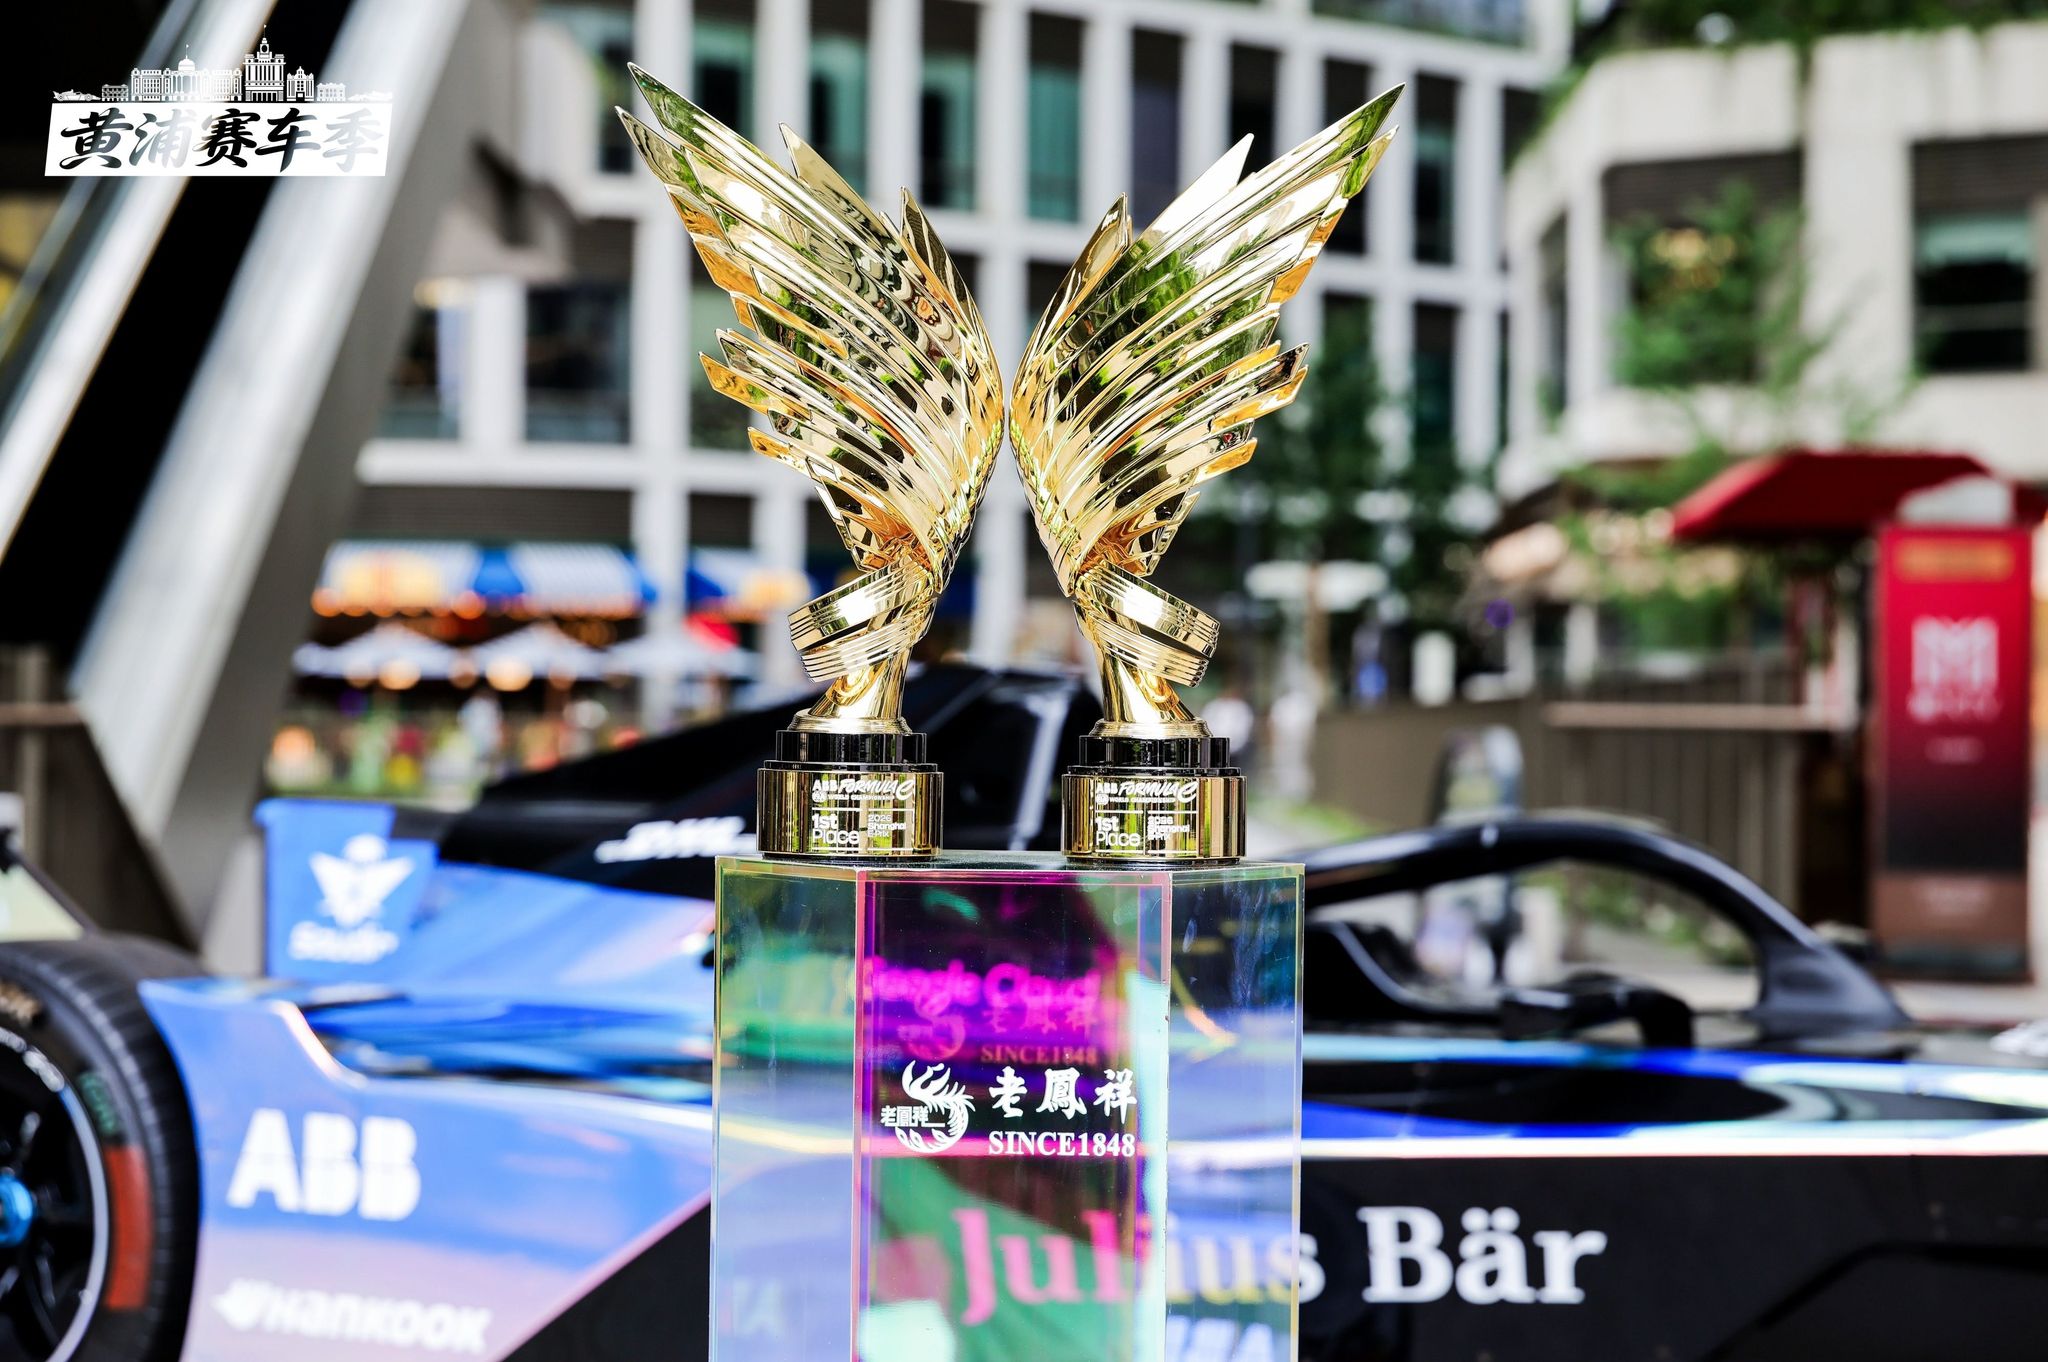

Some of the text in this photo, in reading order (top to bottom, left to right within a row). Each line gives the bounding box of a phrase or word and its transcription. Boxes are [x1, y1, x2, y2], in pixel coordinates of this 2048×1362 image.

[812, 779, 838, 792] ABB
[838, 778, 899, 794] FORMULA
[1096, 782, 1118, 794] ABB
[1118, 781, 1181, 797] FORMULA
[812, 813, 838, 829] 1st
[1095, 816, 1120, 832] 1st
[813, 829, 860, 845] Place
[1096, 831, 1141, 847] Place
[988, 1065, 1137, 1124] 老鳳祥
[881, 1105, 929, 1127] 老鳳祥
[988, 1130, 1136, 1157] SINCE1848
[226, 1107, 422, 1221] ABB
[952, 1206, 1608, 1327] Julius Bär
